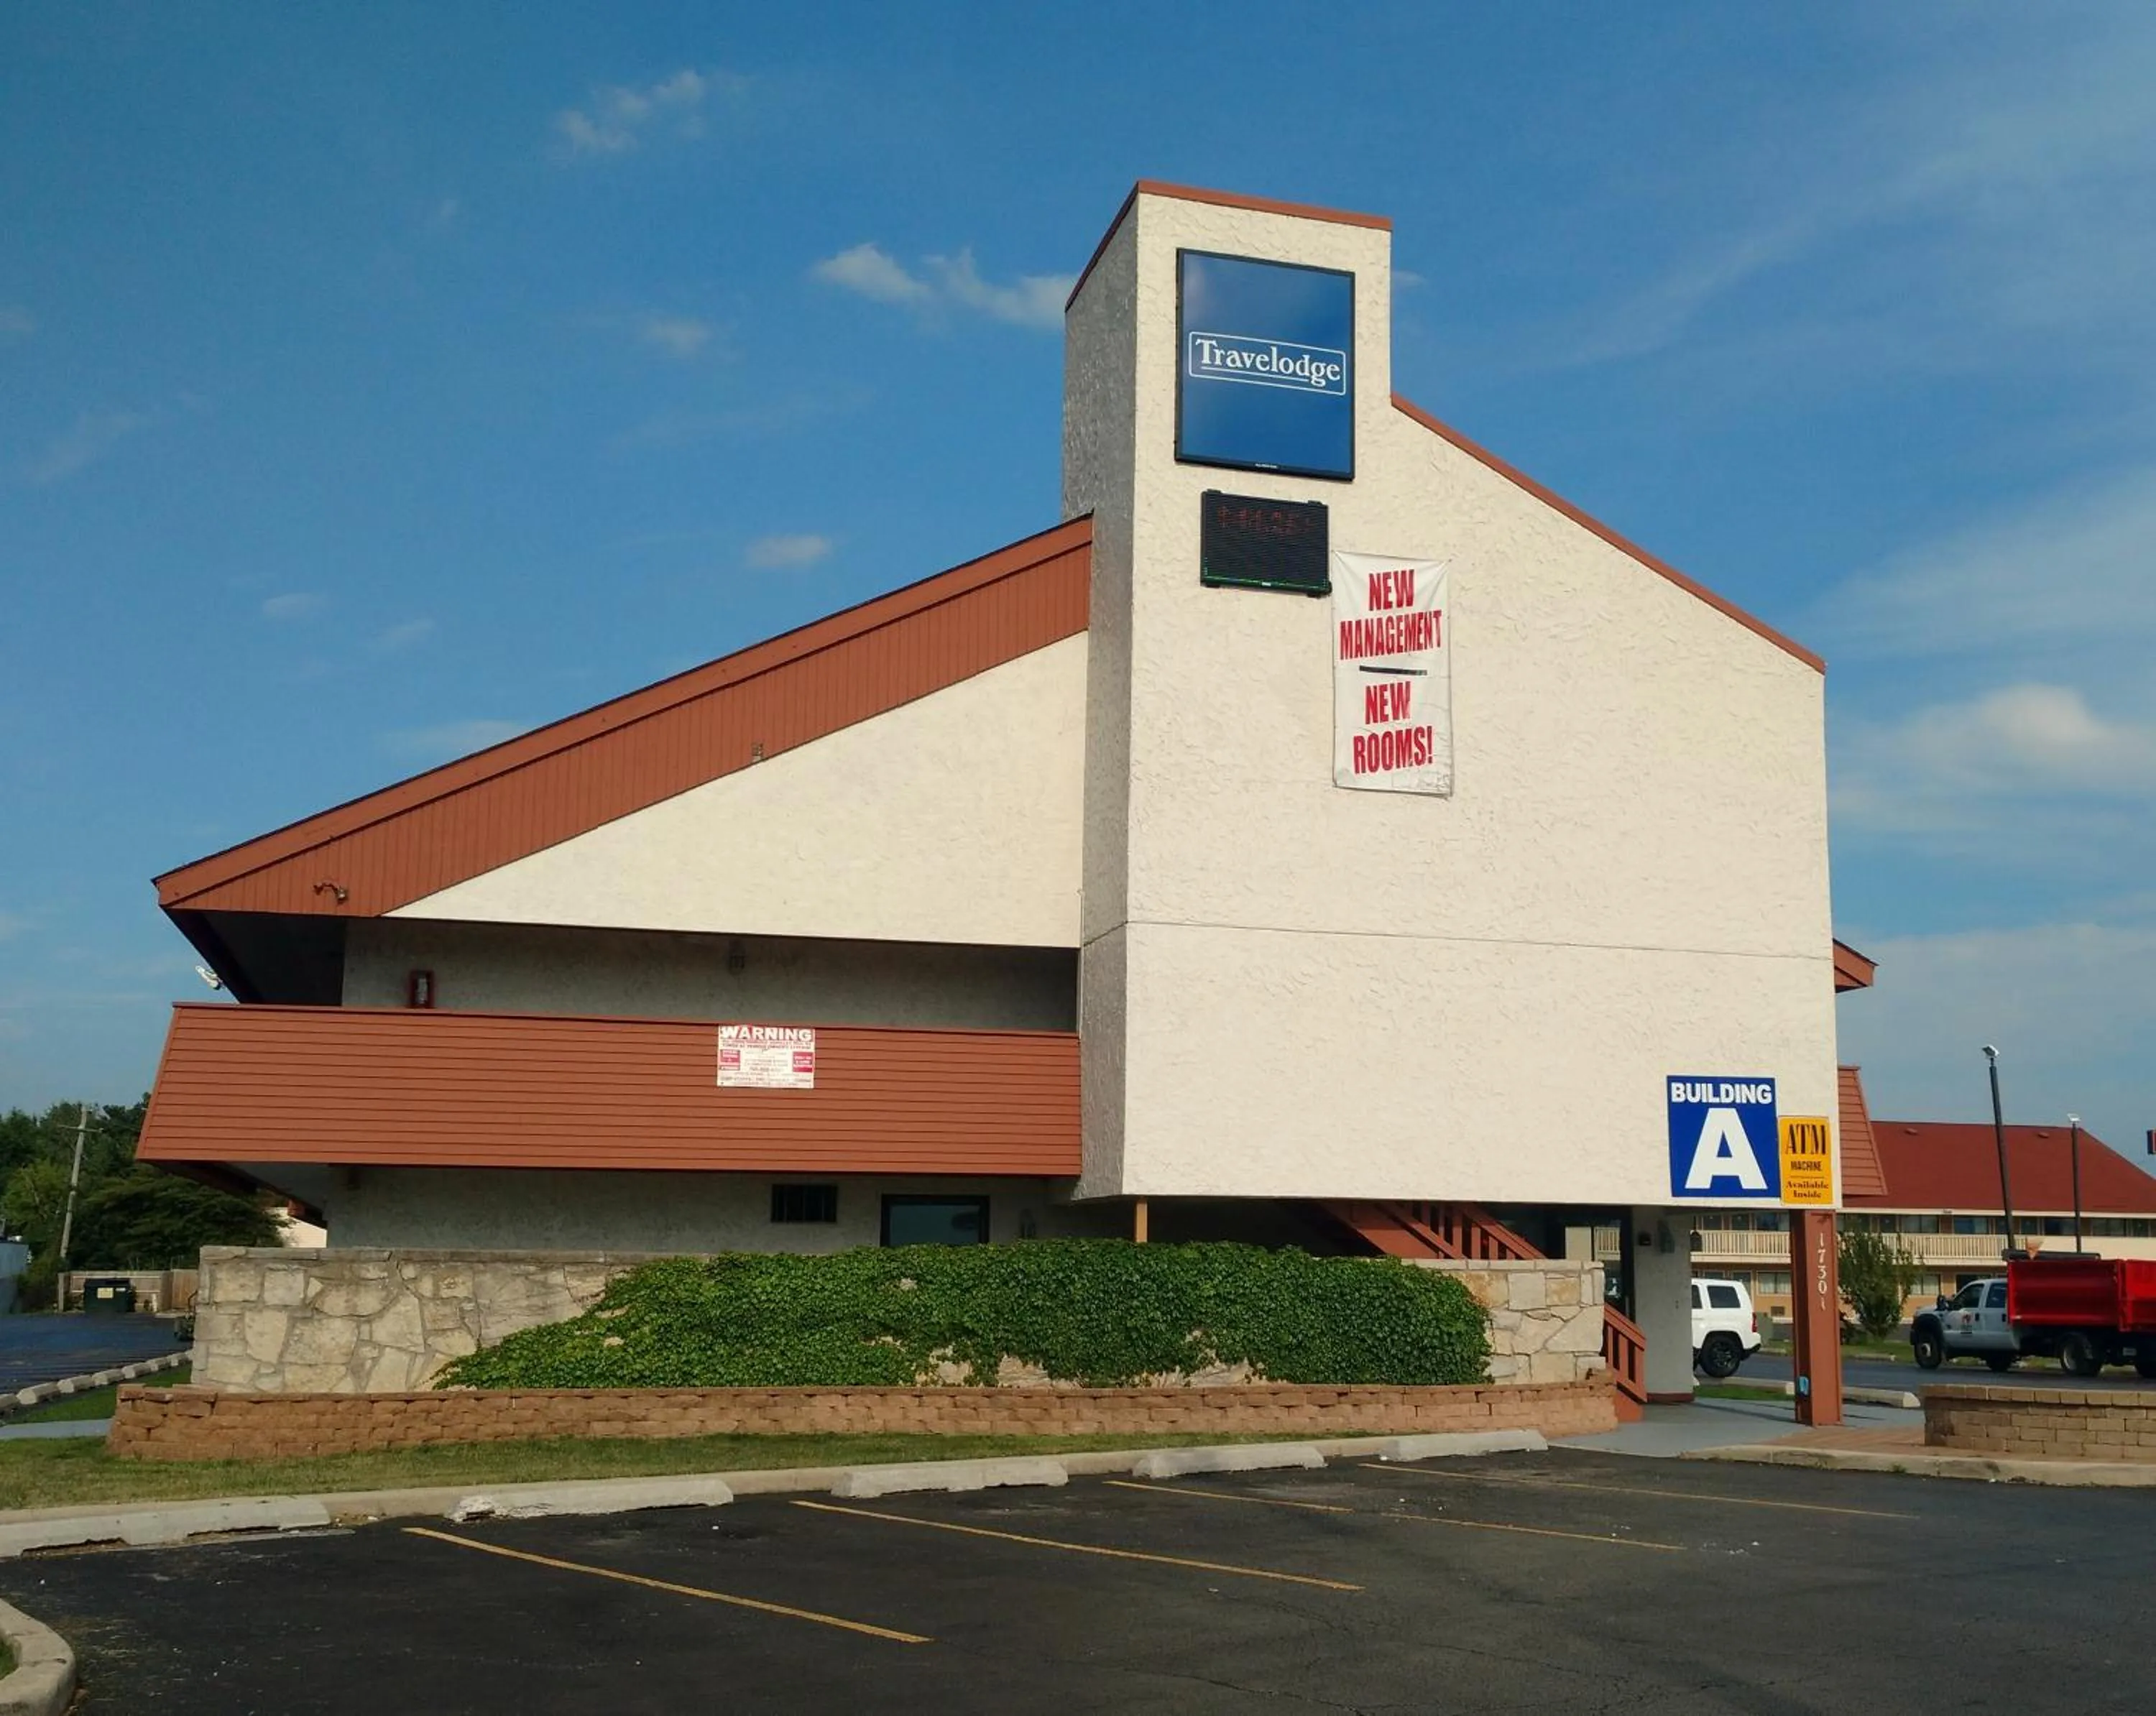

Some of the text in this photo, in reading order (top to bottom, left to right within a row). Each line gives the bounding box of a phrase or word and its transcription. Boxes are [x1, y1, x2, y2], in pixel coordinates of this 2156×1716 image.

[1195, 338, 1340, 387] Travelodge
[1368, 569, 1414, 611] NEW
[1340, 609, 1442, 660] MANAGEMENT
[1365, 681, 1411, 724] NEW
[1353, 725, 1434, 774] ROOMS!
[721, 1025, 812, 1041] WARNING
[1671, 1082, 1772, 1104] BUILDING
[1685, 1107, 1768, 1190] A
[1785, 1123, 1827, 1155] ATM
[1787, 1181, 1829, 1189] Available
[1790, 1161, 1823, 1171] MACHINE
[1793, 1189, 1822, 1198] Inside
[1818, 1232, 1828, 1311] 17301
